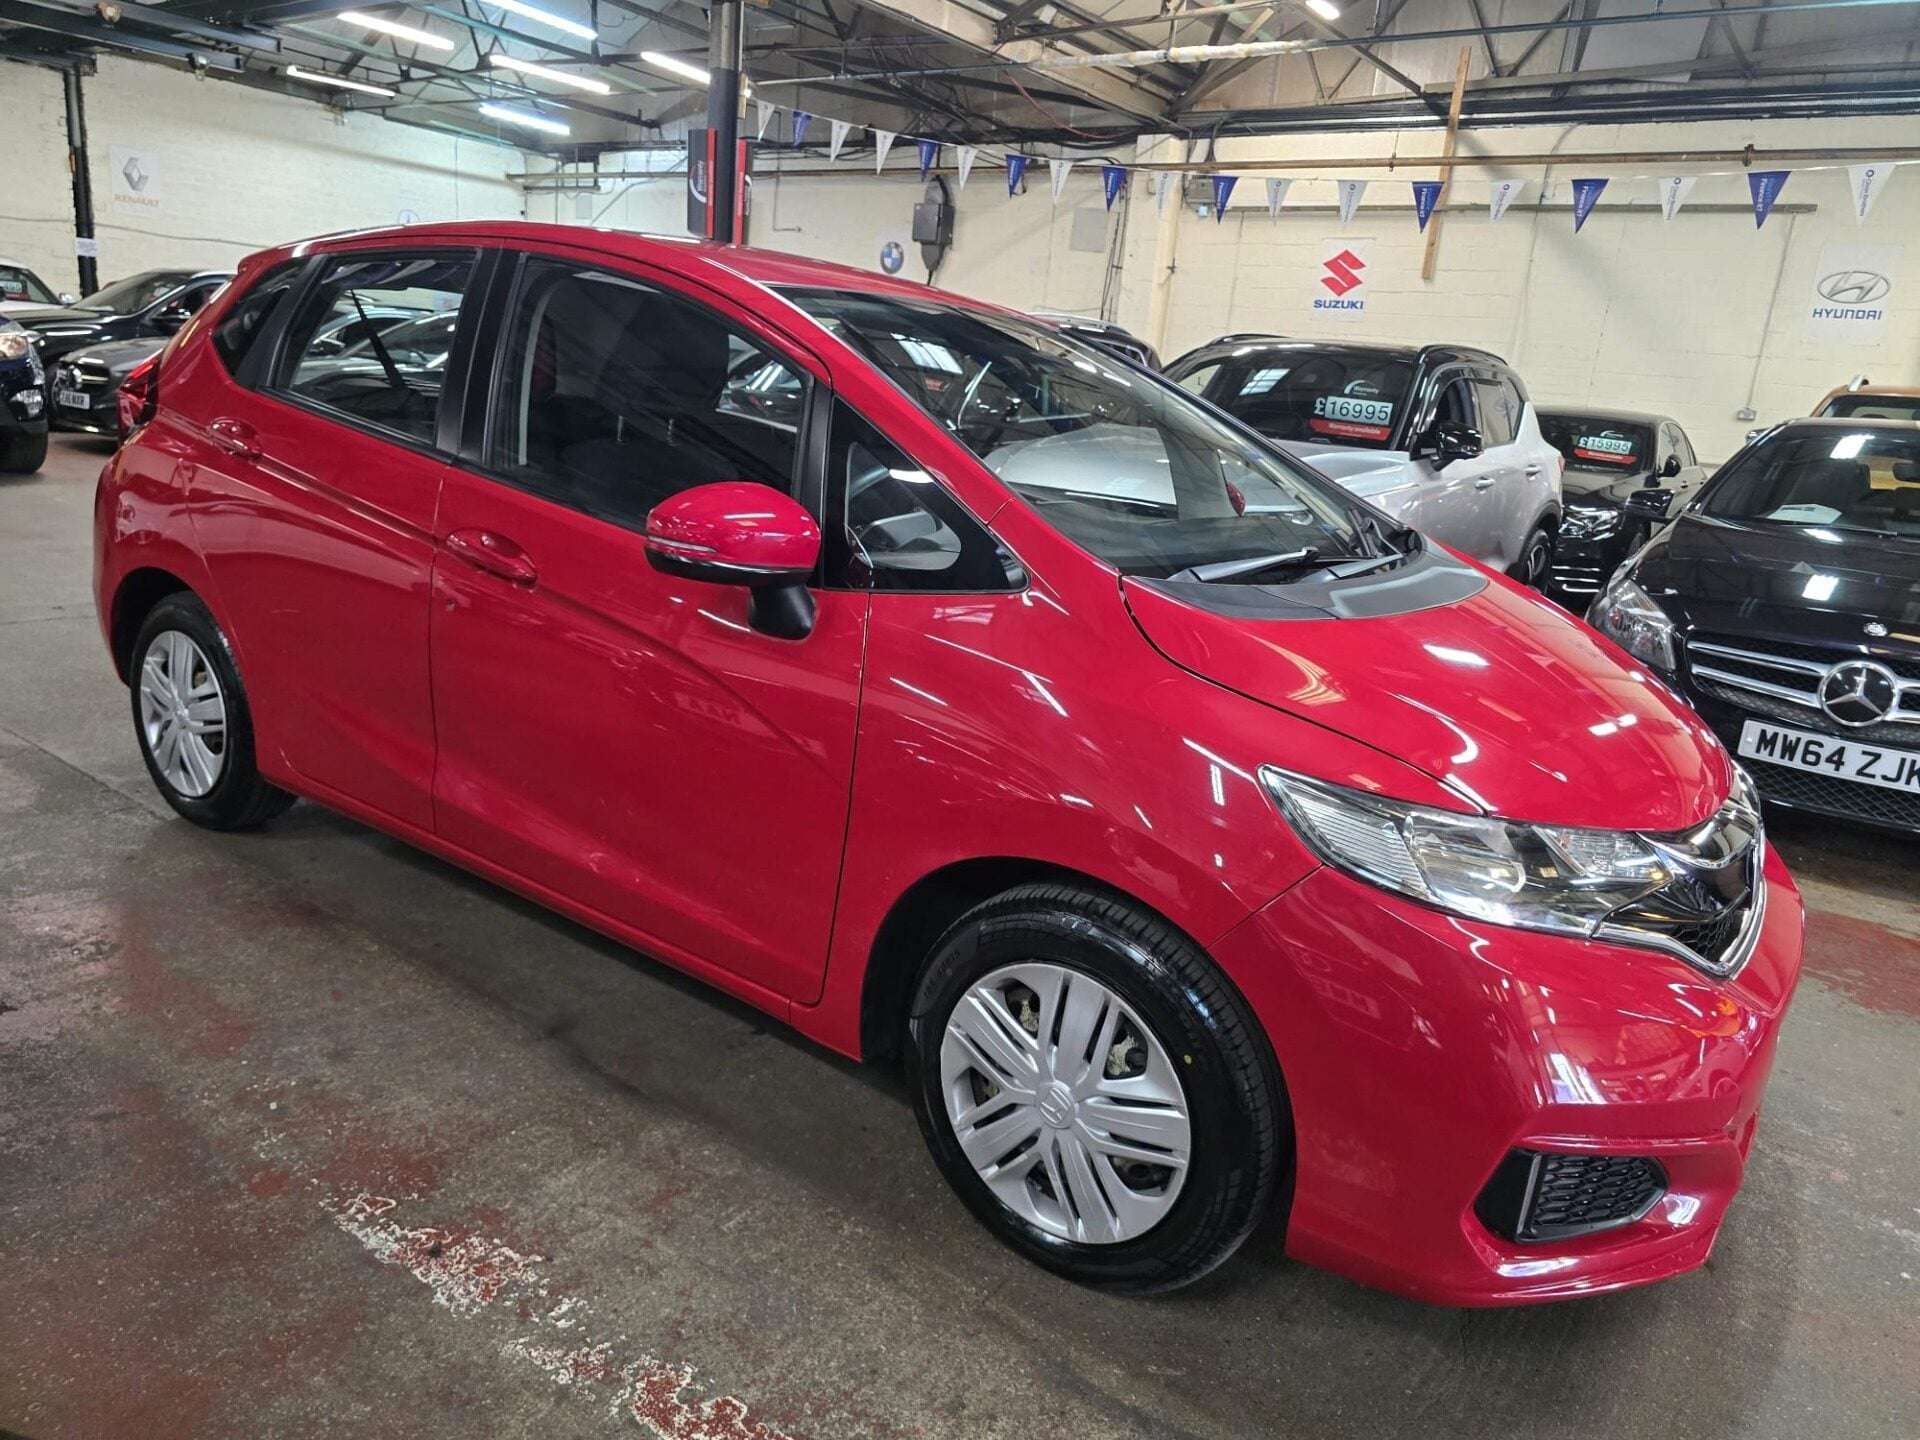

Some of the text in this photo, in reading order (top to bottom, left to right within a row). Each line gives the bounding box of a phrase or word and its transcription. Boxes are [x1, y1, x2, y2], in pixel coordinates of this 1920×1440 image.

[1313, 299, 1364, 310] SUZUKI
[1812, 308, 1883, 320] HYUNDAI
[1313, 397, 1390, 421] £16995
[1755, 728, 1920, 787] MW64 ZJK
